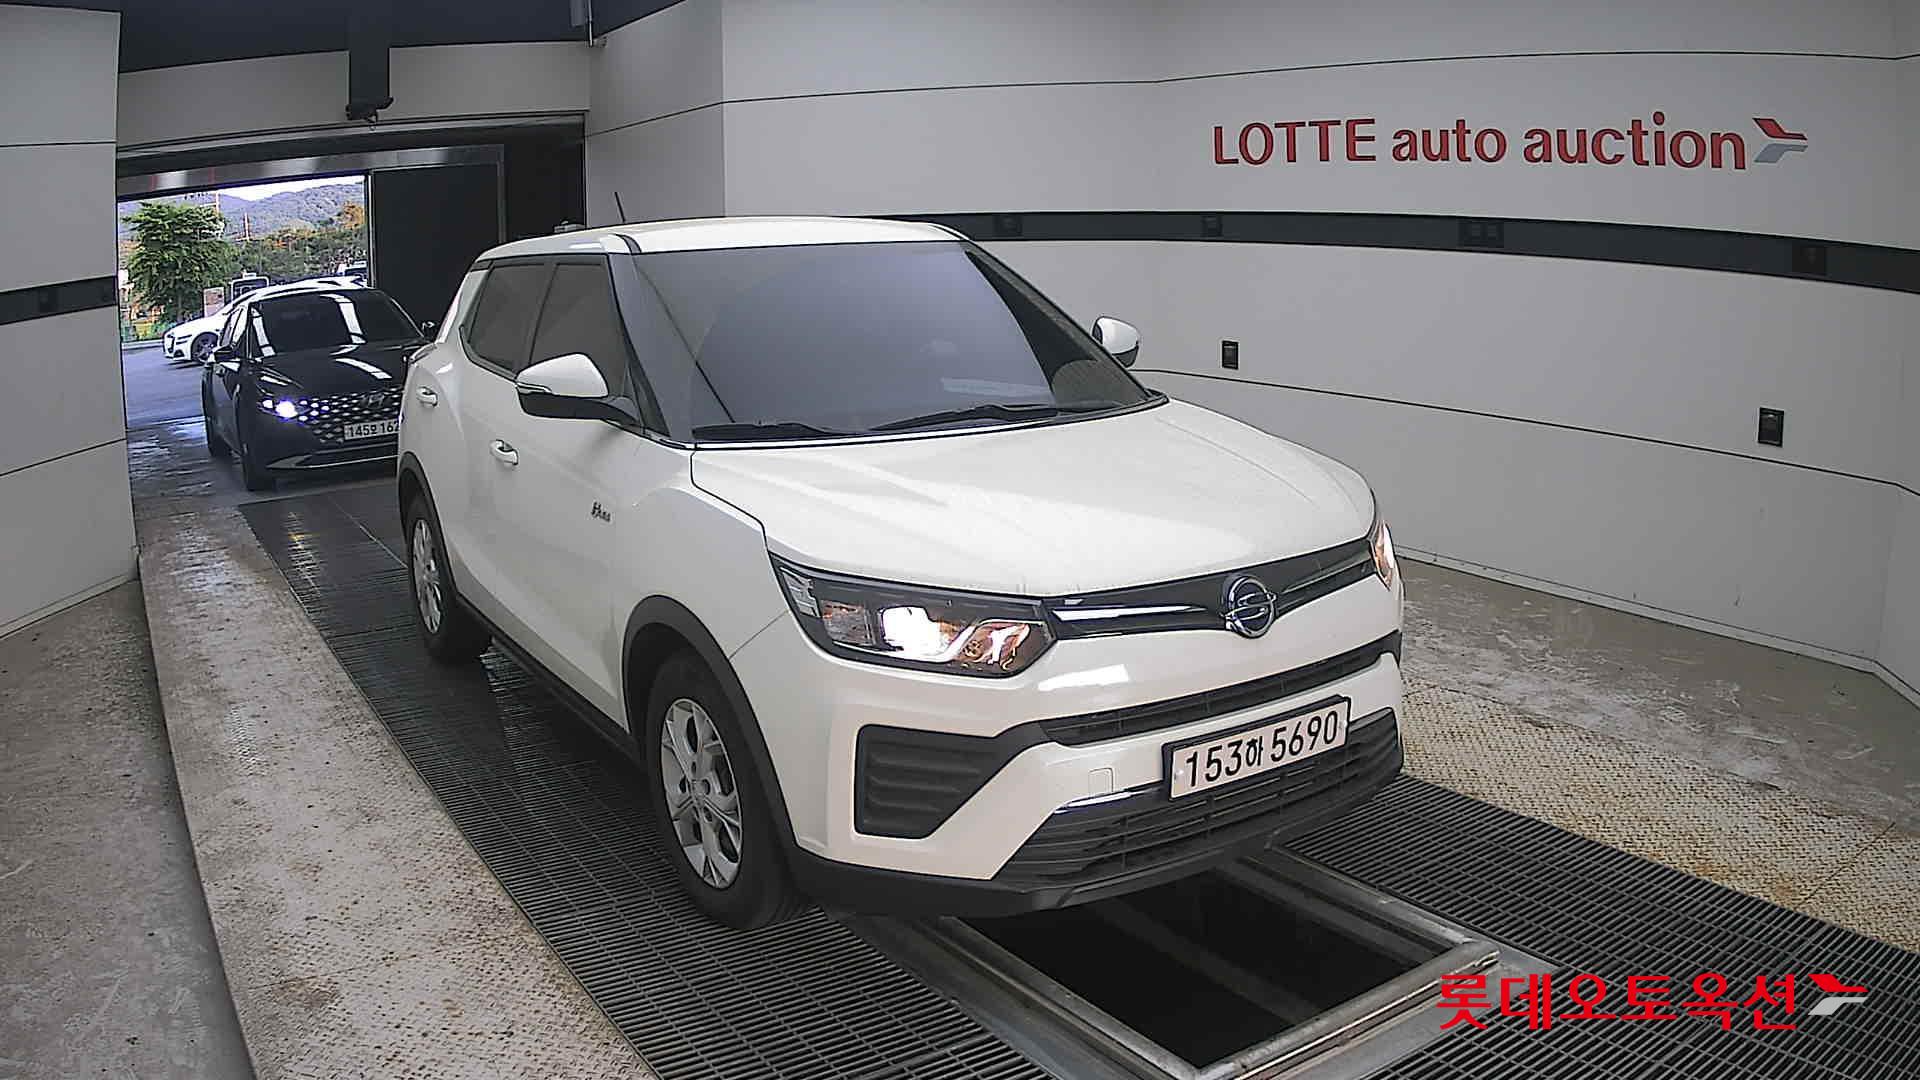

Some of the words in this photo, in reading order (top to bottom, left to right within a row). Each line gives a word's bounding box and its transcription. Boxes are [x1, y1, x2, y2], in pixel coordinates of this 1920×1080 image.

[1213, 118, 1376, 165] LOTTE
[1392, 118, 1507, 163] auto
[1523, 111, 1747, 170] auction
[1186, 735, 1263, 787] 153하
[1271, 710, 1338, 762] 5690
